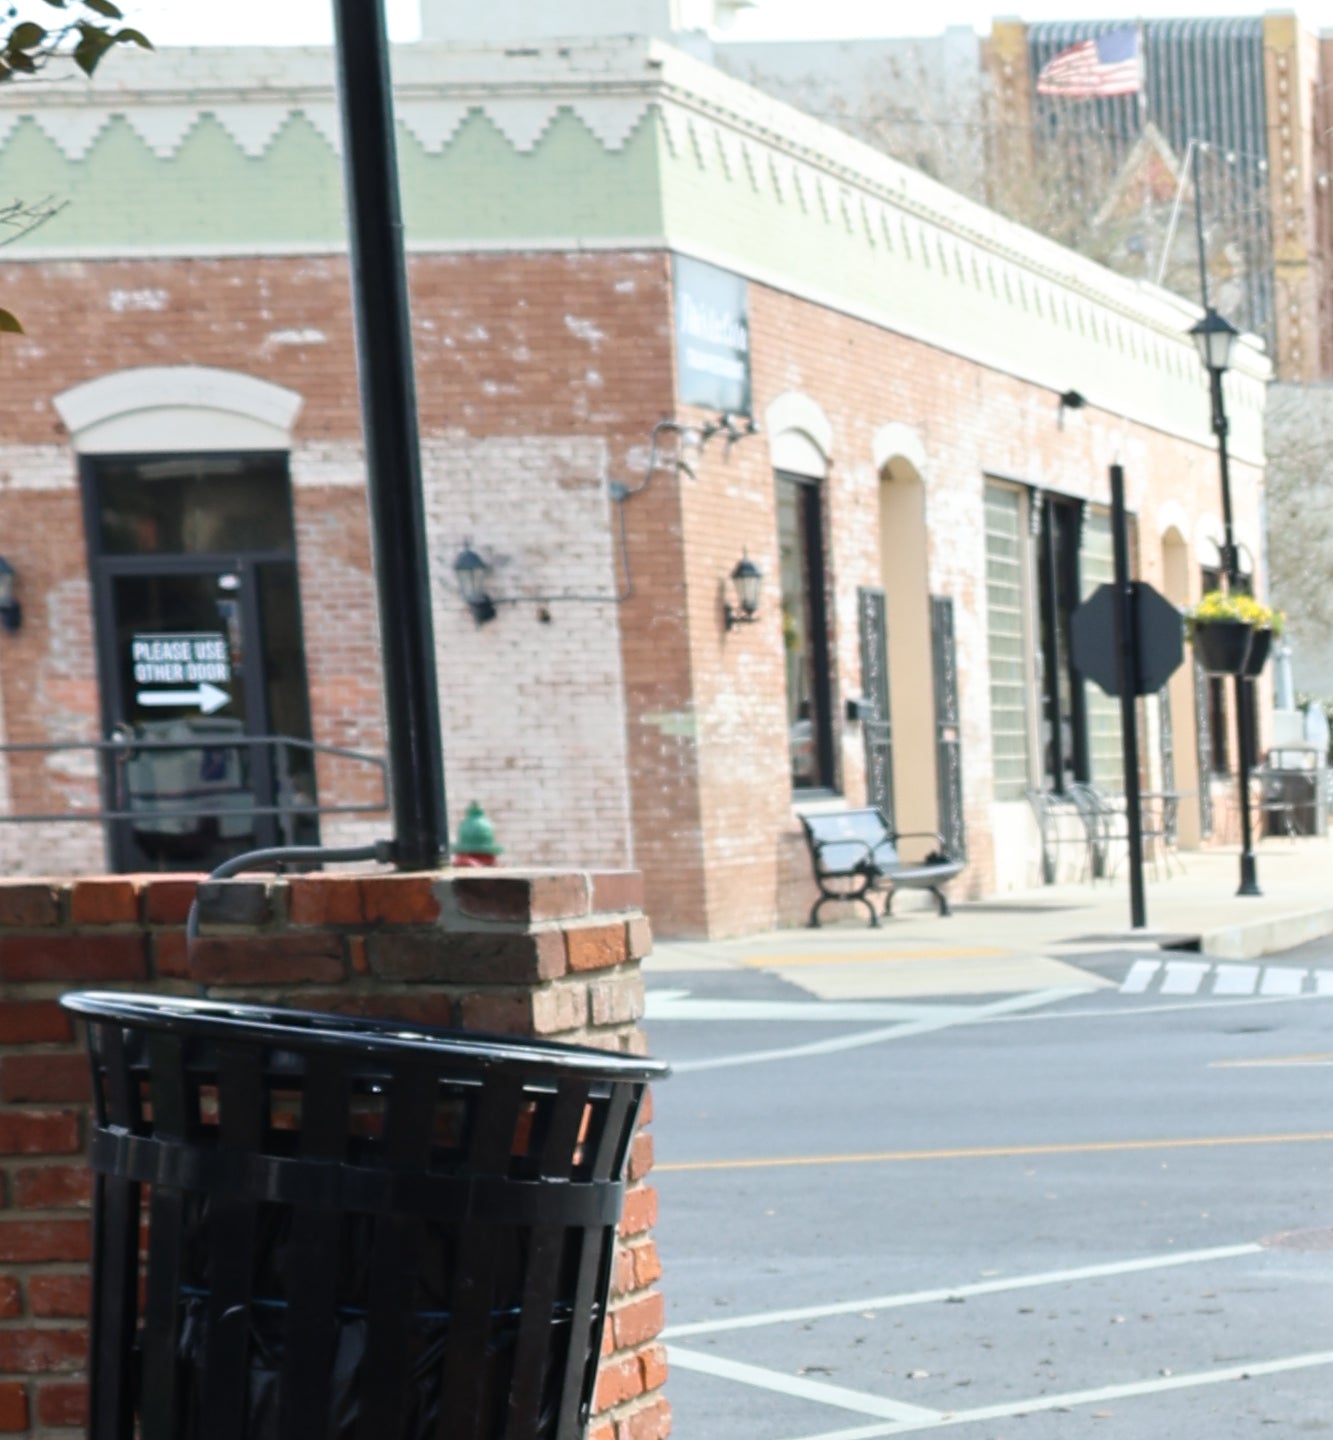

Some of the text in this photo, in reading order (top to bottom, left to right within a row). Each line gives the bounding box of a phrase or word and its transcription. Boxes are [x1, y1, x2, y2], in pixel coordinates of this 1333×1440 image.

[133, 641, 226, 660] PLEASE USE
[134, 662, 227, 681] OTHER DOOR
